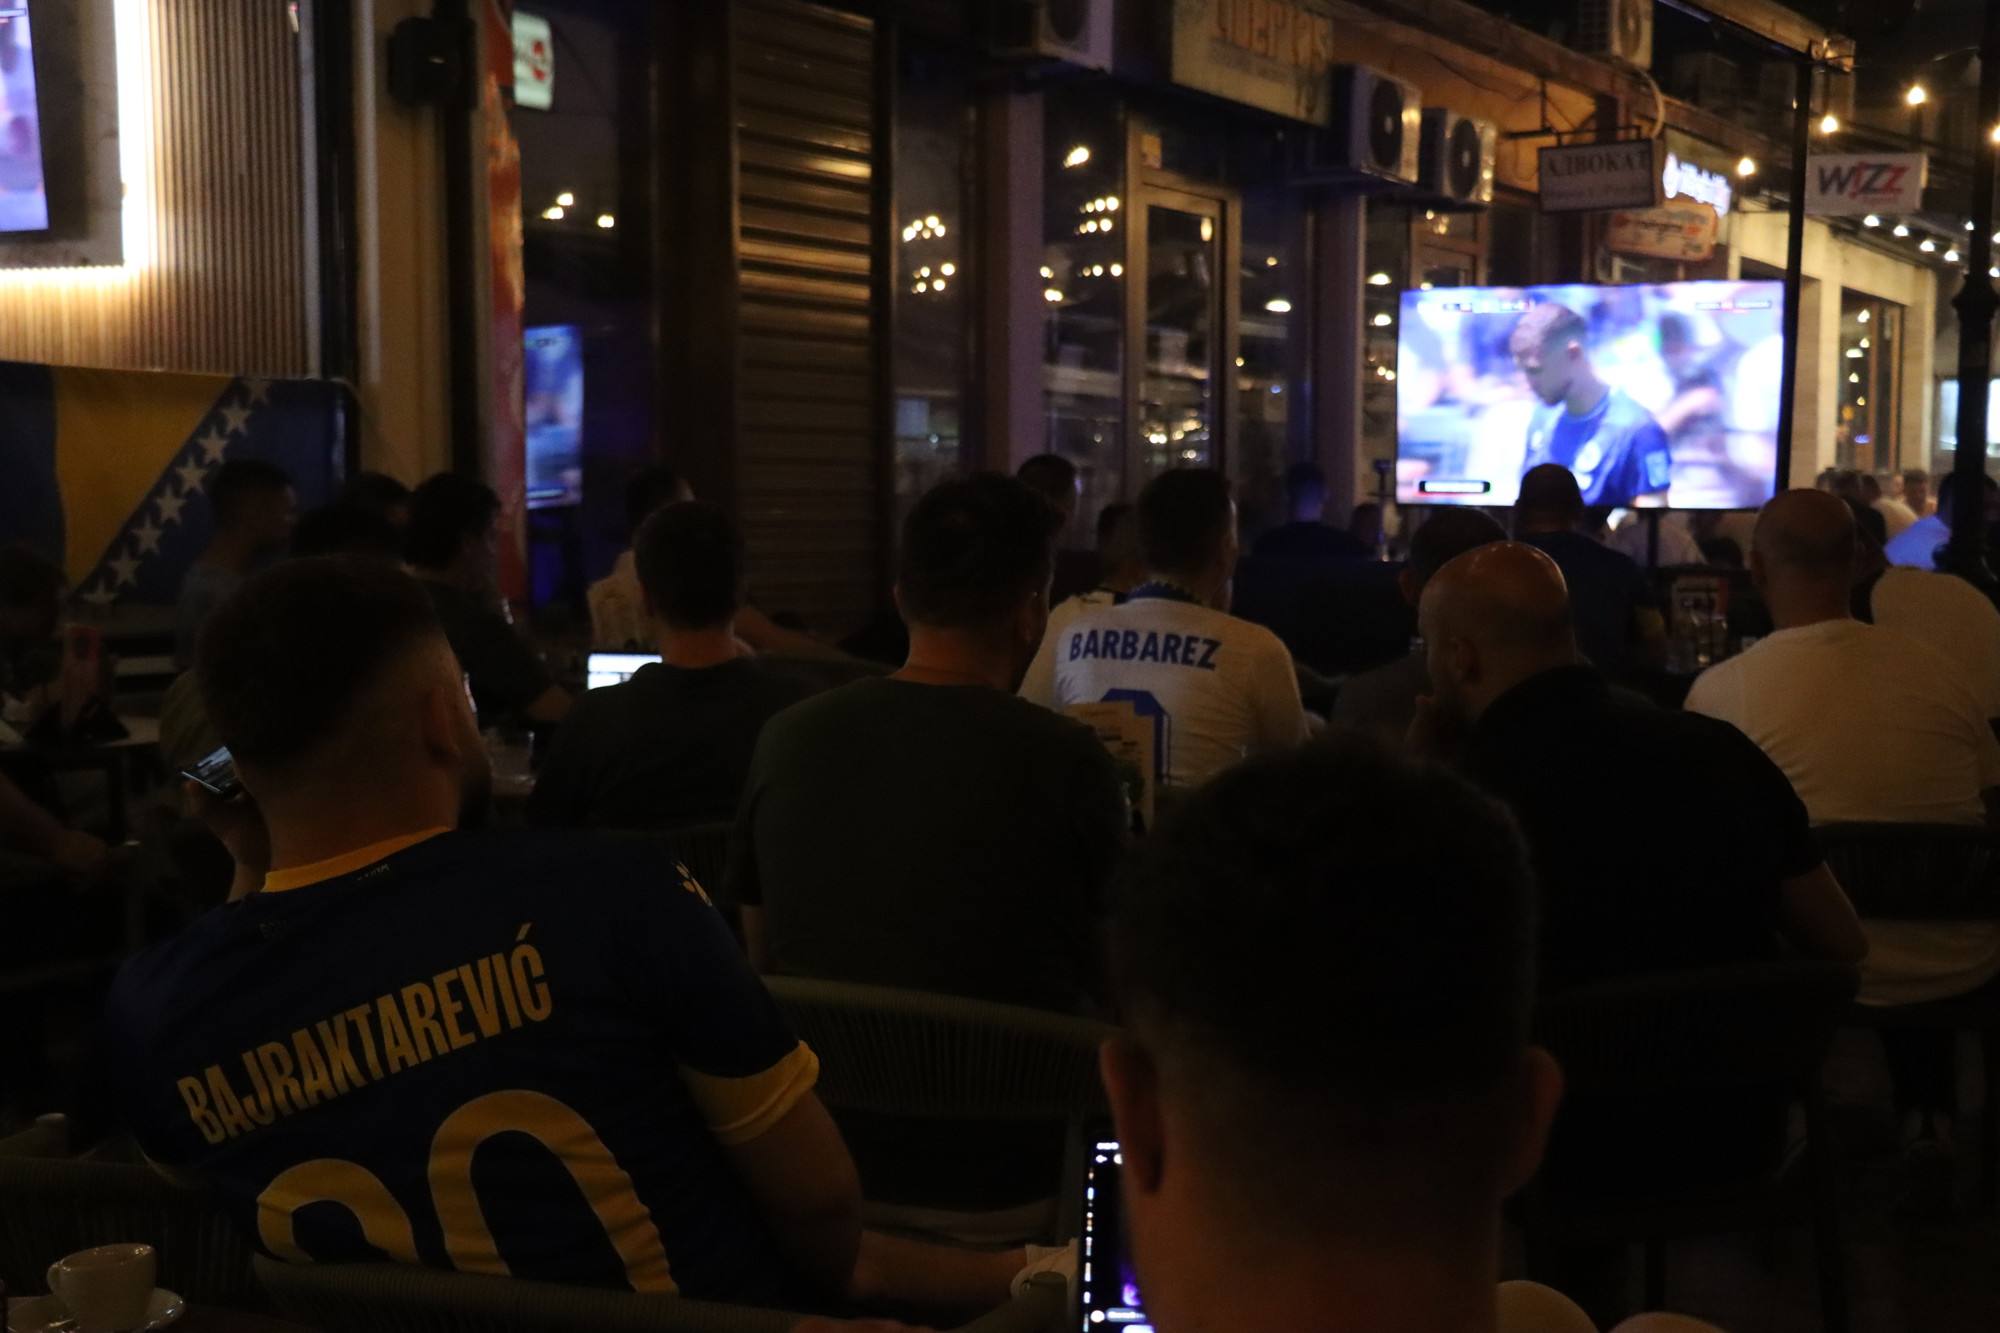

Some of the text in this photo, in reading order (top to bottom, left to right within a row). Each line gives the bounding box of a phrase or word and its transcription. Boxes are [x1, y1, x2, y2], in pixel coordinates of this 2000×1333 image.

[1818, 161, 1910, 199] WIZZ
[1069, 628, 1223, 671] BARBAREZ
[176, 922, 554, 1146] BAJRAKTAREVIĆ
